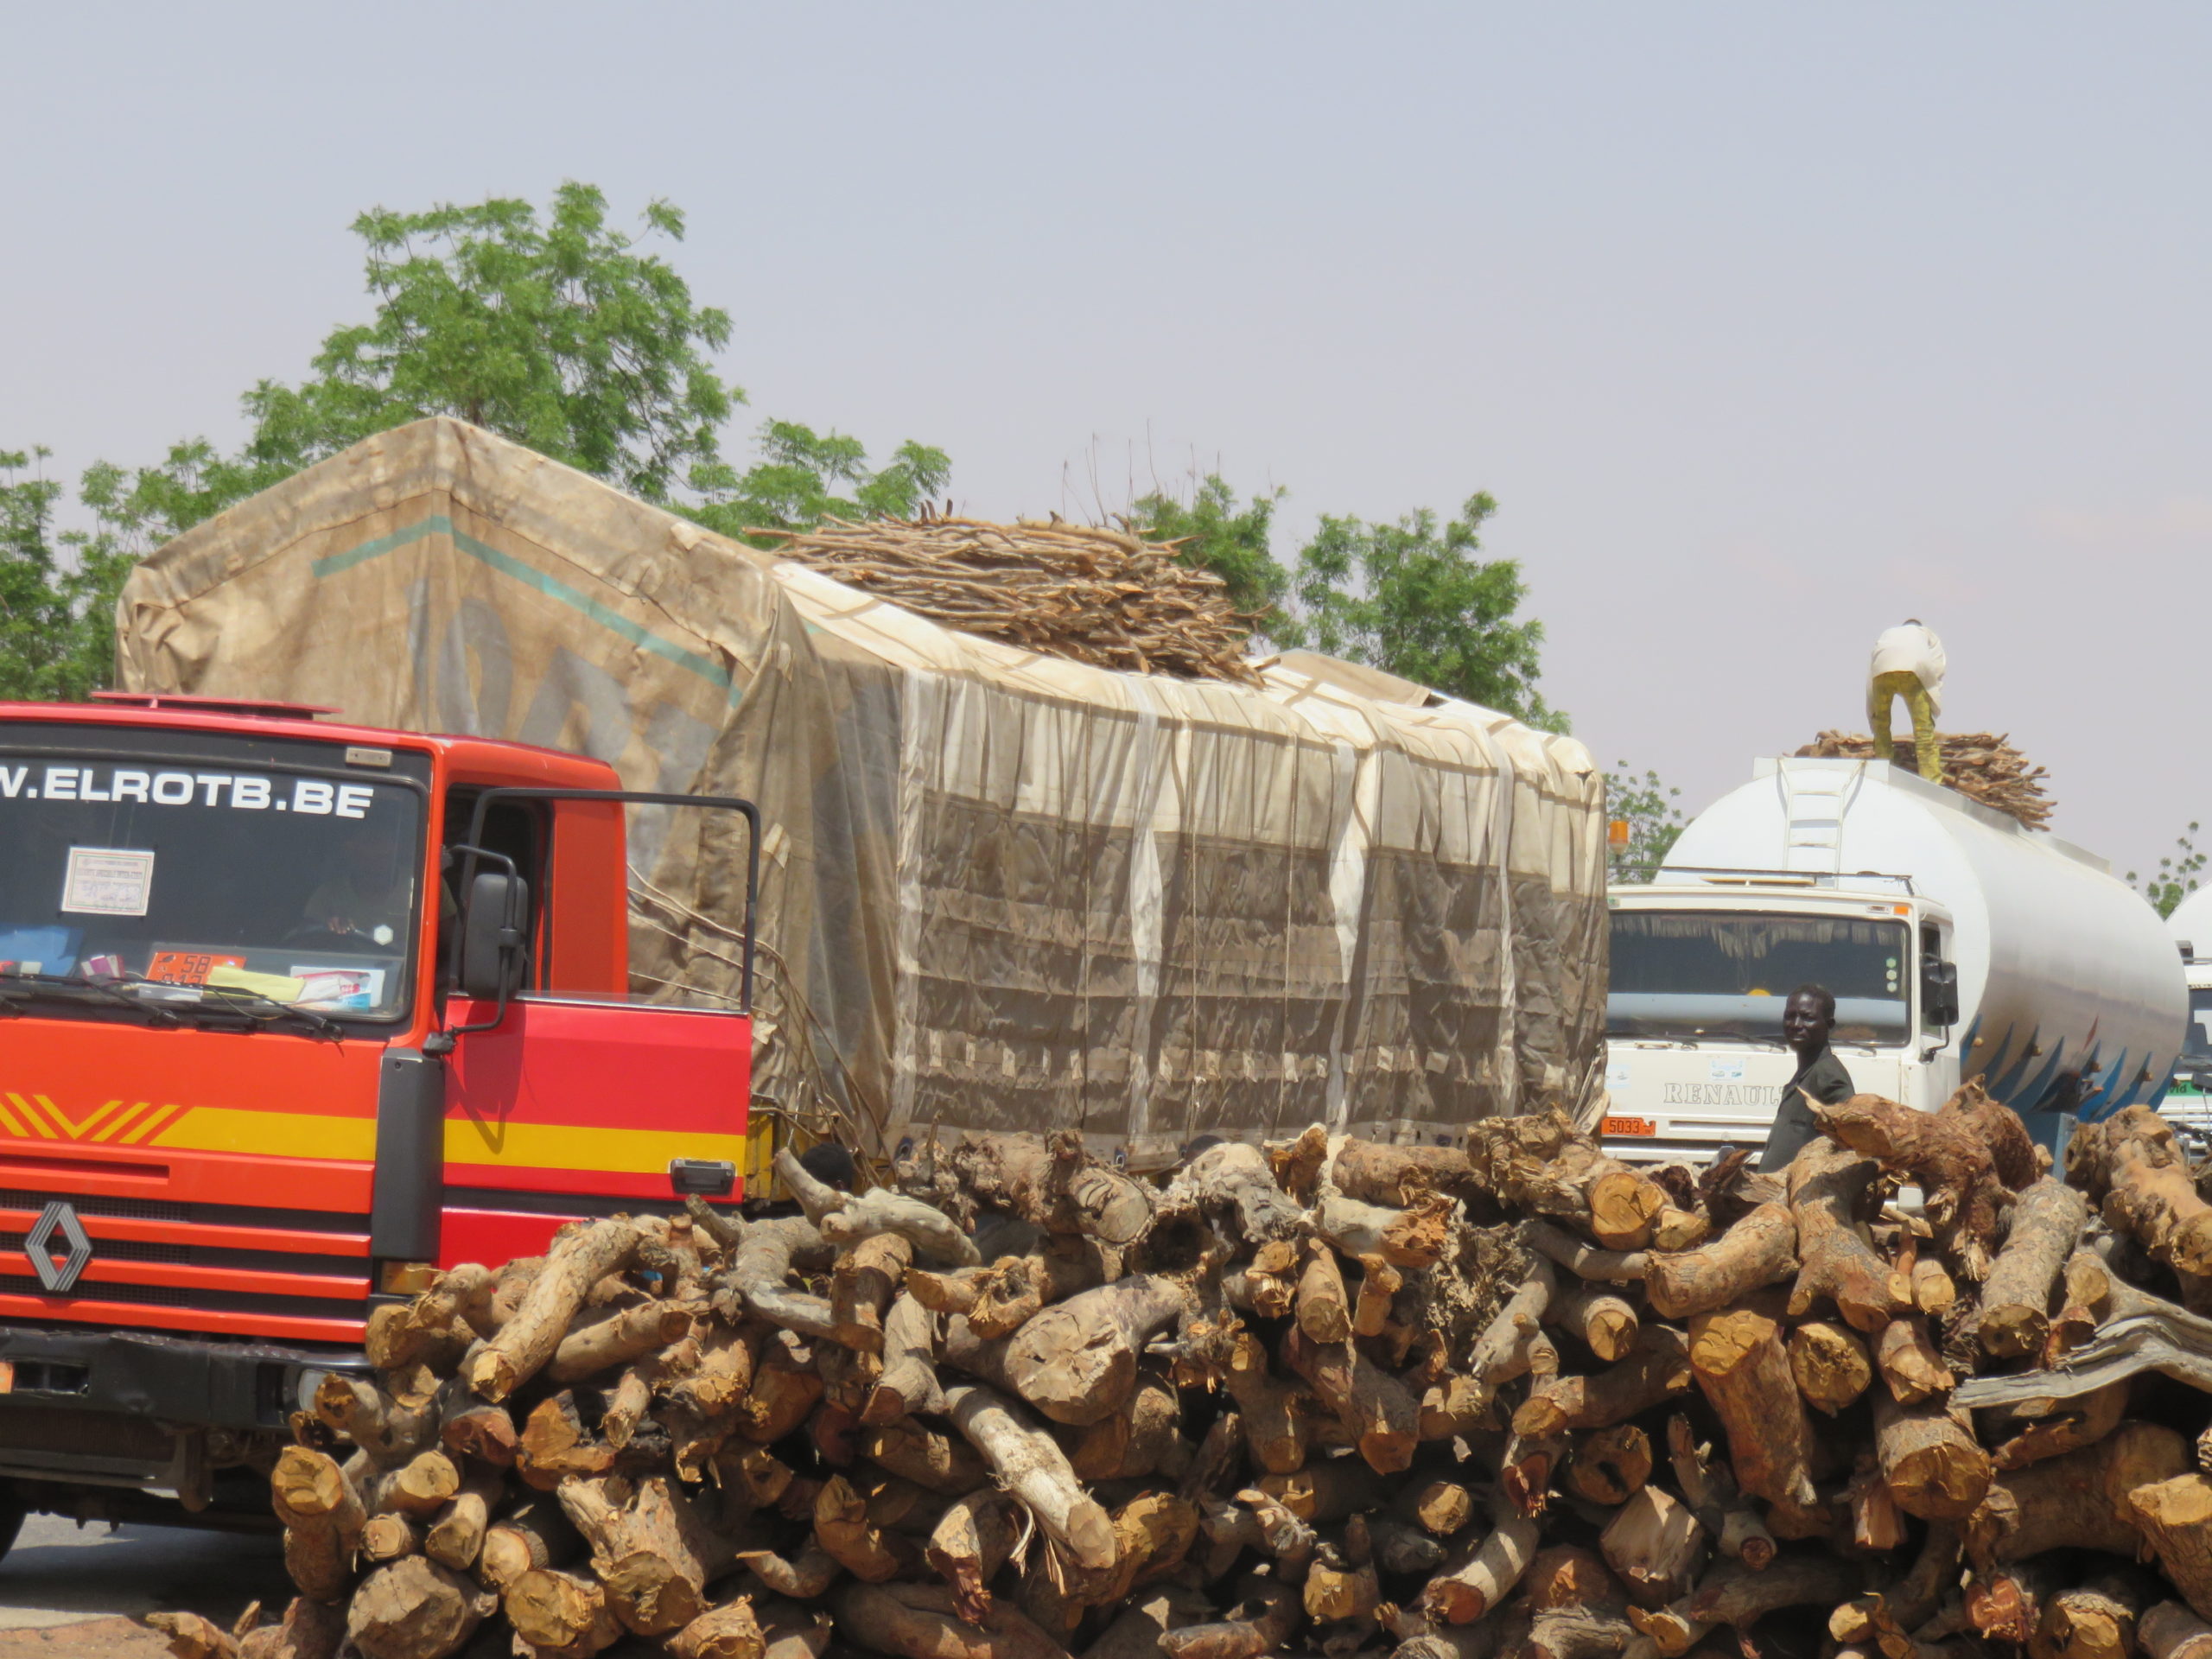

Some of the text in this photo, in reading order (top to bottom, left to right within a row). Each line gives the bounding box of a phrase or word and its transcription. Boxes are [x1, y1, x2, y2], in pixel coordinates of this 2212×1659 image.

[1663, 1083, 1784, 1107] RENAUL
[2167, 1084, 2187, 1094] vid
[1609, 1119, 1640, 1135] 5033
